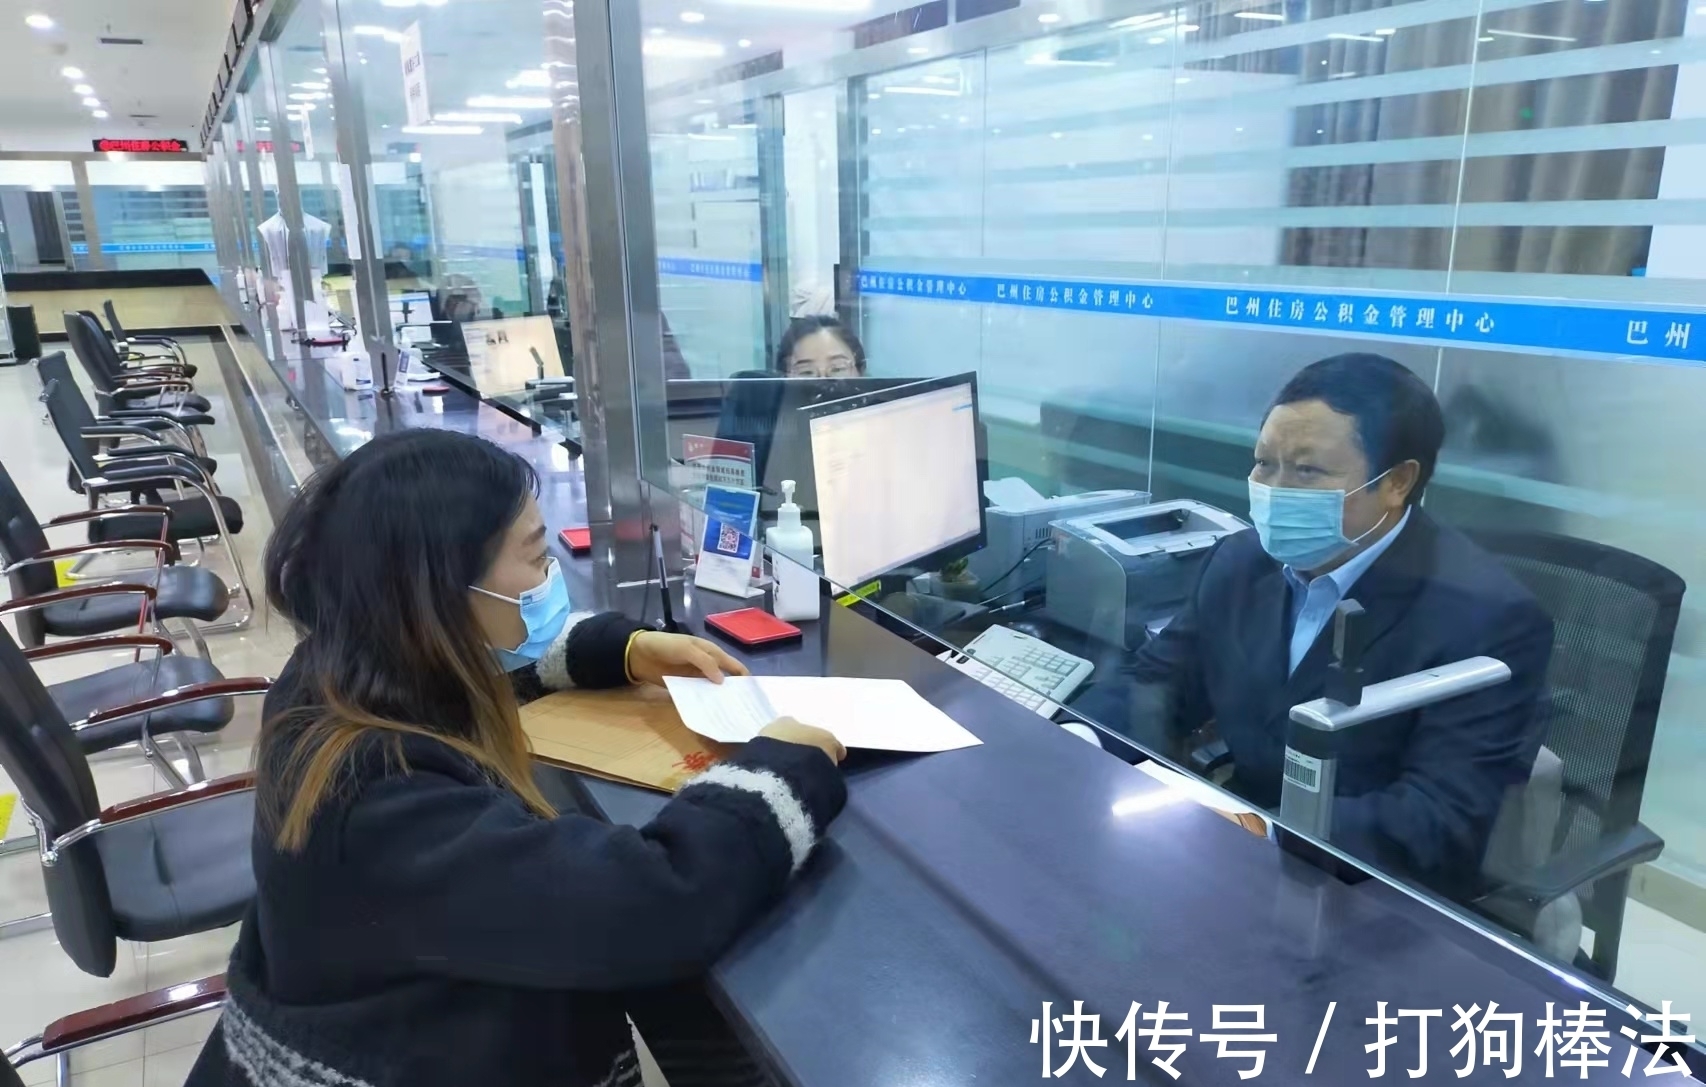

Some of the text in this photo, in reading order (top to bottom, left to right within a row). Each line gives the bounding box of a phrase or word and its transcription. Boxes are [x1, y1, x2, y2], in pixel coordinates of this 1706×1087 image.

[997, 283, 1153, 309] 巴州住房公积金管理中心
[1225, 296, 1494, 333] 巴州住房公积金管理中心
[1626, 320, 1691, 349] 巴州
